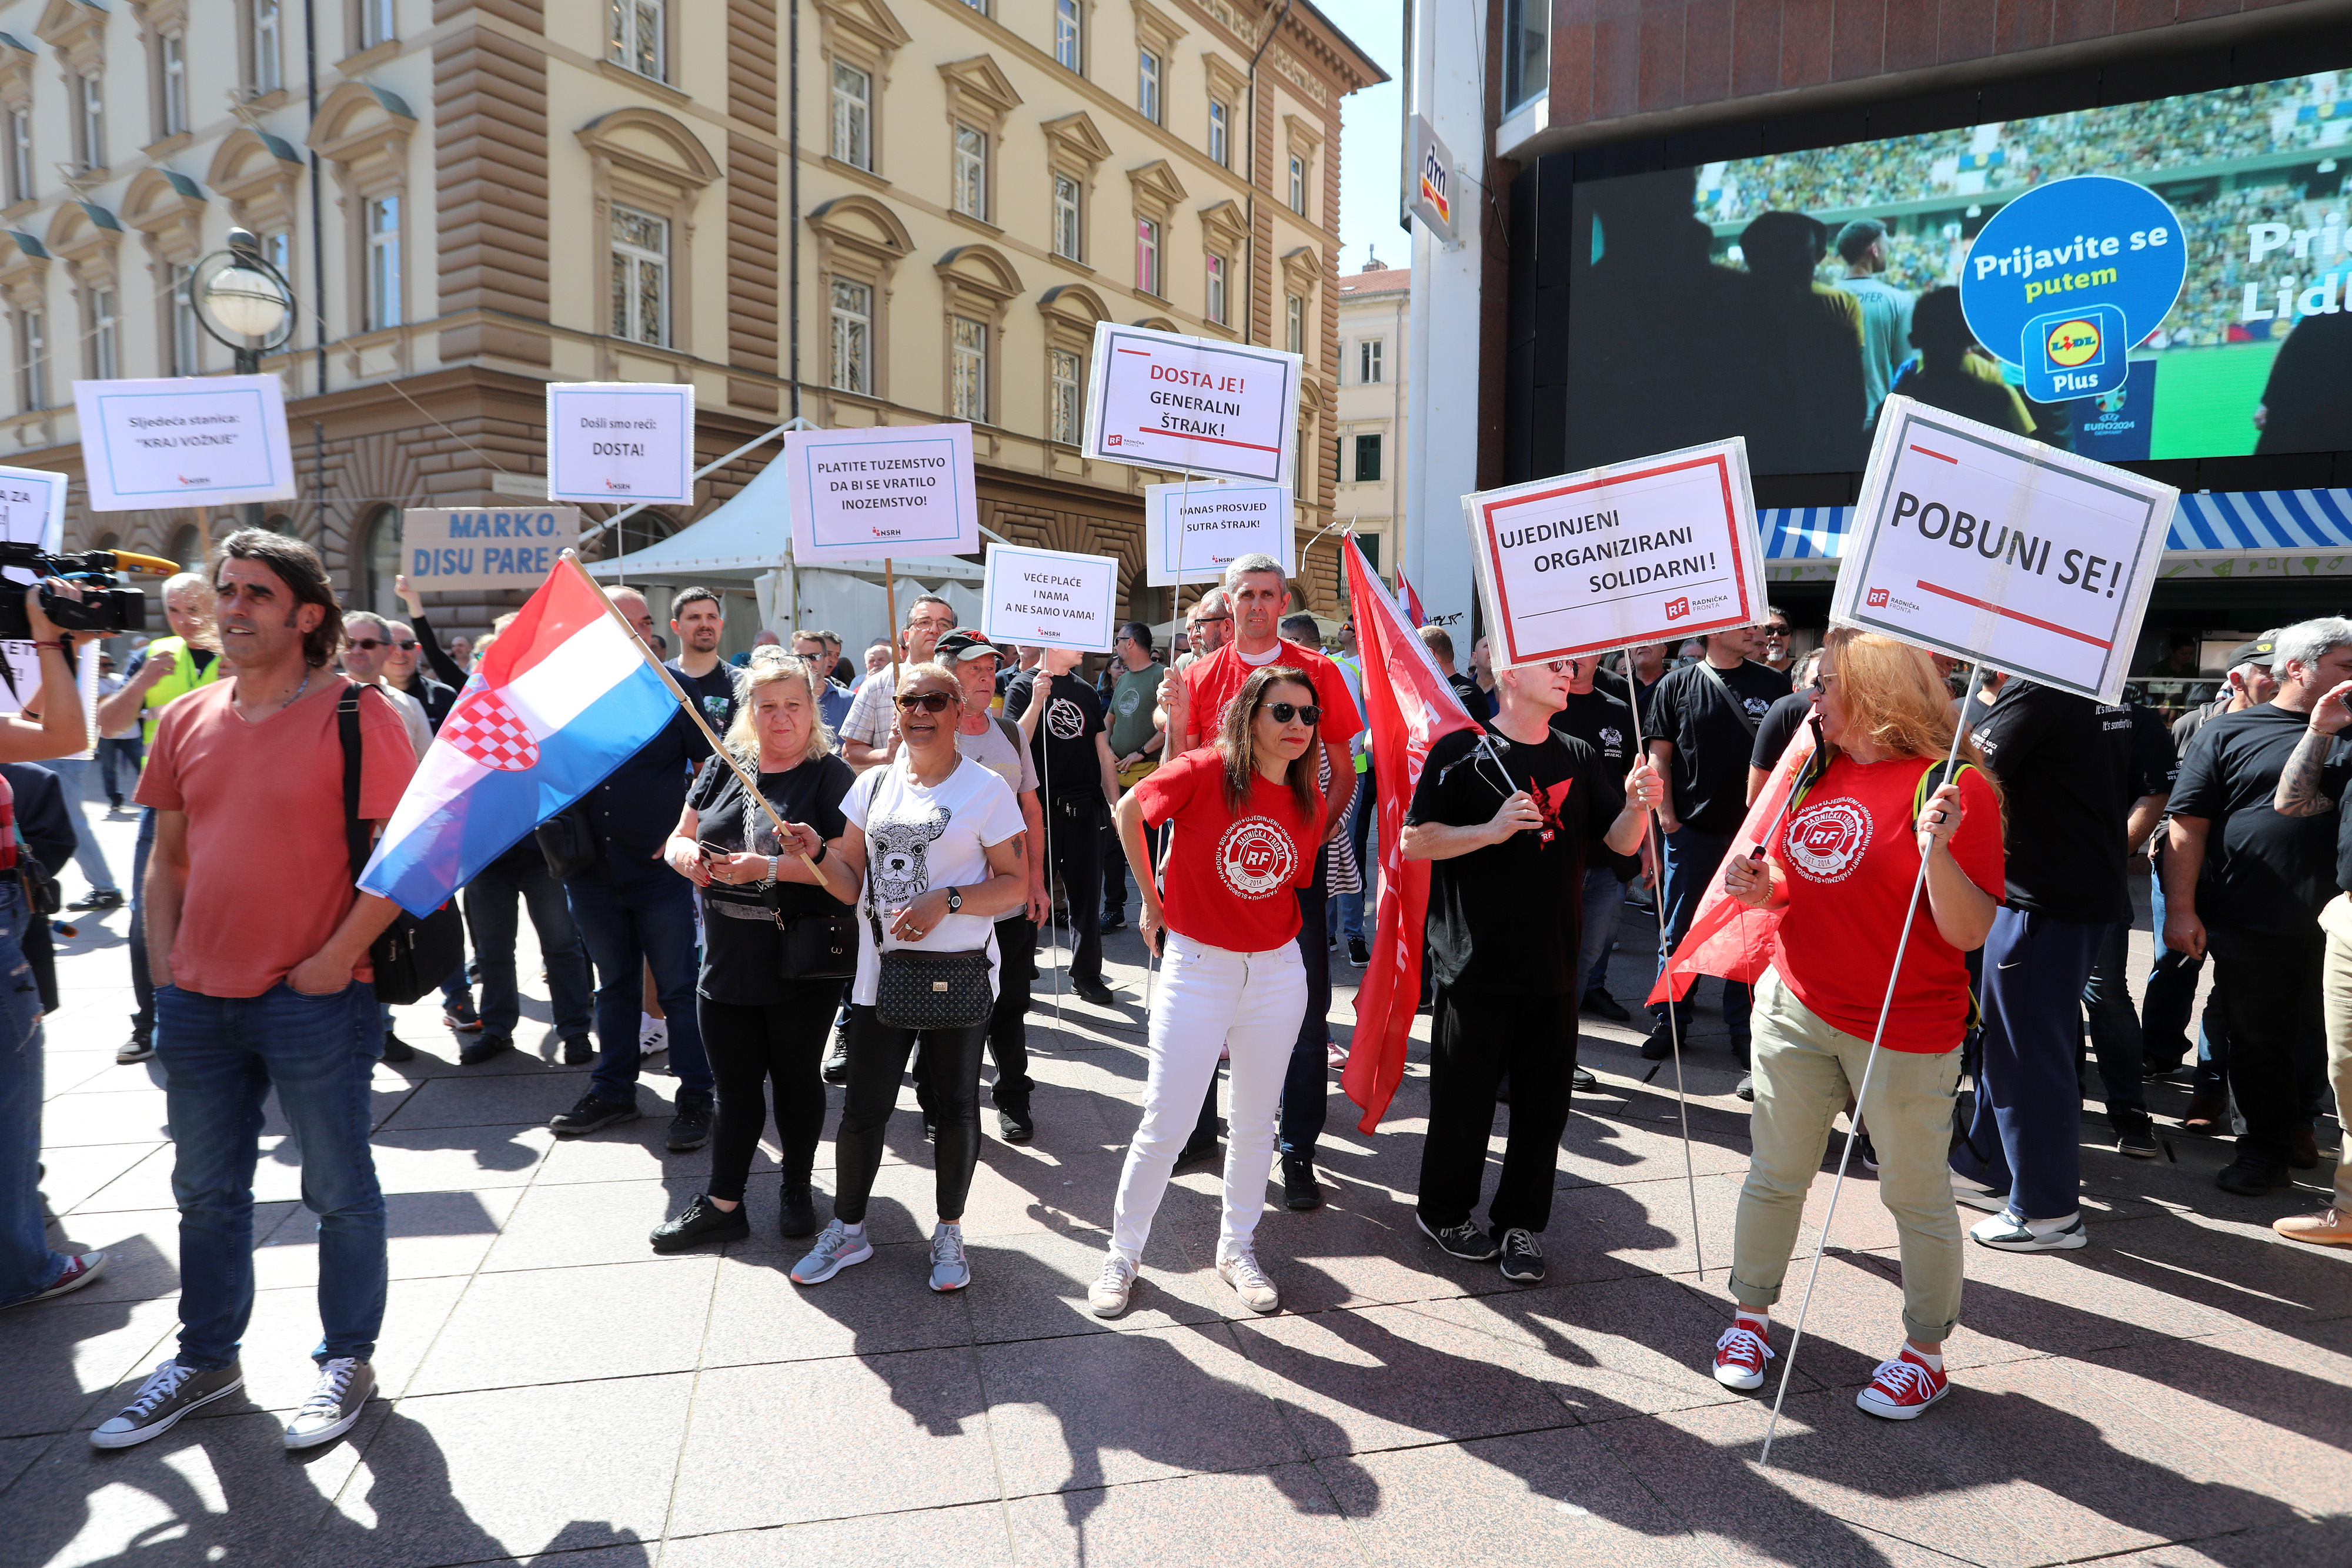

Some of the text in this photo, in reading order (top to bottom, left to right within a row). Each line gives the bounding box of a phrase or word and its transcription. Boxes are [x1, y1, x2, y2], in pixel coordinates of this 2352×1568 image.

[1426, 145, 1446, 196] dm
[1975, 226, 2169, 280] Prijavite se
[2024, 268, 2117, 303] putem
[1150, 364, 1213, 389] DOSTA
[2053, 373, 2099, 393] Plus
[1150, 390, 1240, 416] GENERALNI
[129, 413, 240, 430] Sljedeća stanica:
[580, 417, 657, 429] Došli smo reći:
[1161, 412, 1225, 437] ŠTRAJK!
[2084, 421, 2135, 432] EURO2024
[593, 442, 644, 456] DOSTA!
[817, 457, 946, 473] PLATITE TUZEMSTVO
[830, 476, 936, 492] DA BI SE VRATILO
[11, 491, 32, 503] ZA
[841, 496, 928, 510] INOZEMSTVO!
[1216, 503, 1267, 512] PROSVJED
[1187, 519, 1260, 532] SUTRA ŠTRAJK!
[1500, 509, 1620, 549] UJEDINJENI
[1534, 526, 1693, 573] ORGANIZIRANI
[1891, 491, 2123, 599] POBUNI SE!
[413, 547, 549, 576] DISU PARE
[1024, 572, 1082, 587] VEĆE PLAĆE
[1033, 590, 1070, 602] I NAMA
[1692, 595, 1728, 606] RADNIČKA
[1869, 593, 1887, 603] RF
[1891, 597, 1919, 611] RADNIČKA
[1005, 603, 1095, 620] A NE SAMO VAMA!
[1669, 601, 1686, 617] RF
[1693, 603, 1720, 611] FRONTA
[1889, 603, 1911, 614] FRONTA
[1823, 796, 1859, 806] UJEDINJENI
[1245, 815, 1279, 828] UJEDINJENI
[1803, 811, 1856, 837] RADNIČKA FRONTA
[1860, 807, 1874, 847] ORGANIZIRANI
[1220, 820, 1242, 846] SOLIDARNI
[1541, 831, 1552, 840] RF
[1809, 831, 1840, 844] RF
[1237, 828, 1285, 860] RADNIČKA FRONTA
[1281, 829, 1298, 871] ORGANIZIRANI
[1782, 834, 1793, 863] NARODU
[1216, 852, 1226, 880] NARODU
[1245, 851, 1271, 865] RF
[1804, 855, 1816, 866] EST.
[1851, 851, 1865, 869] SMRT
[1237, 874, 1248, 884] EST.
[1795, 865, 1822, 884] SLOBODA
[1825, 870, 1852, 884] FAŠIZMU
[1227, 882, 1248, 900] SLOBODA
